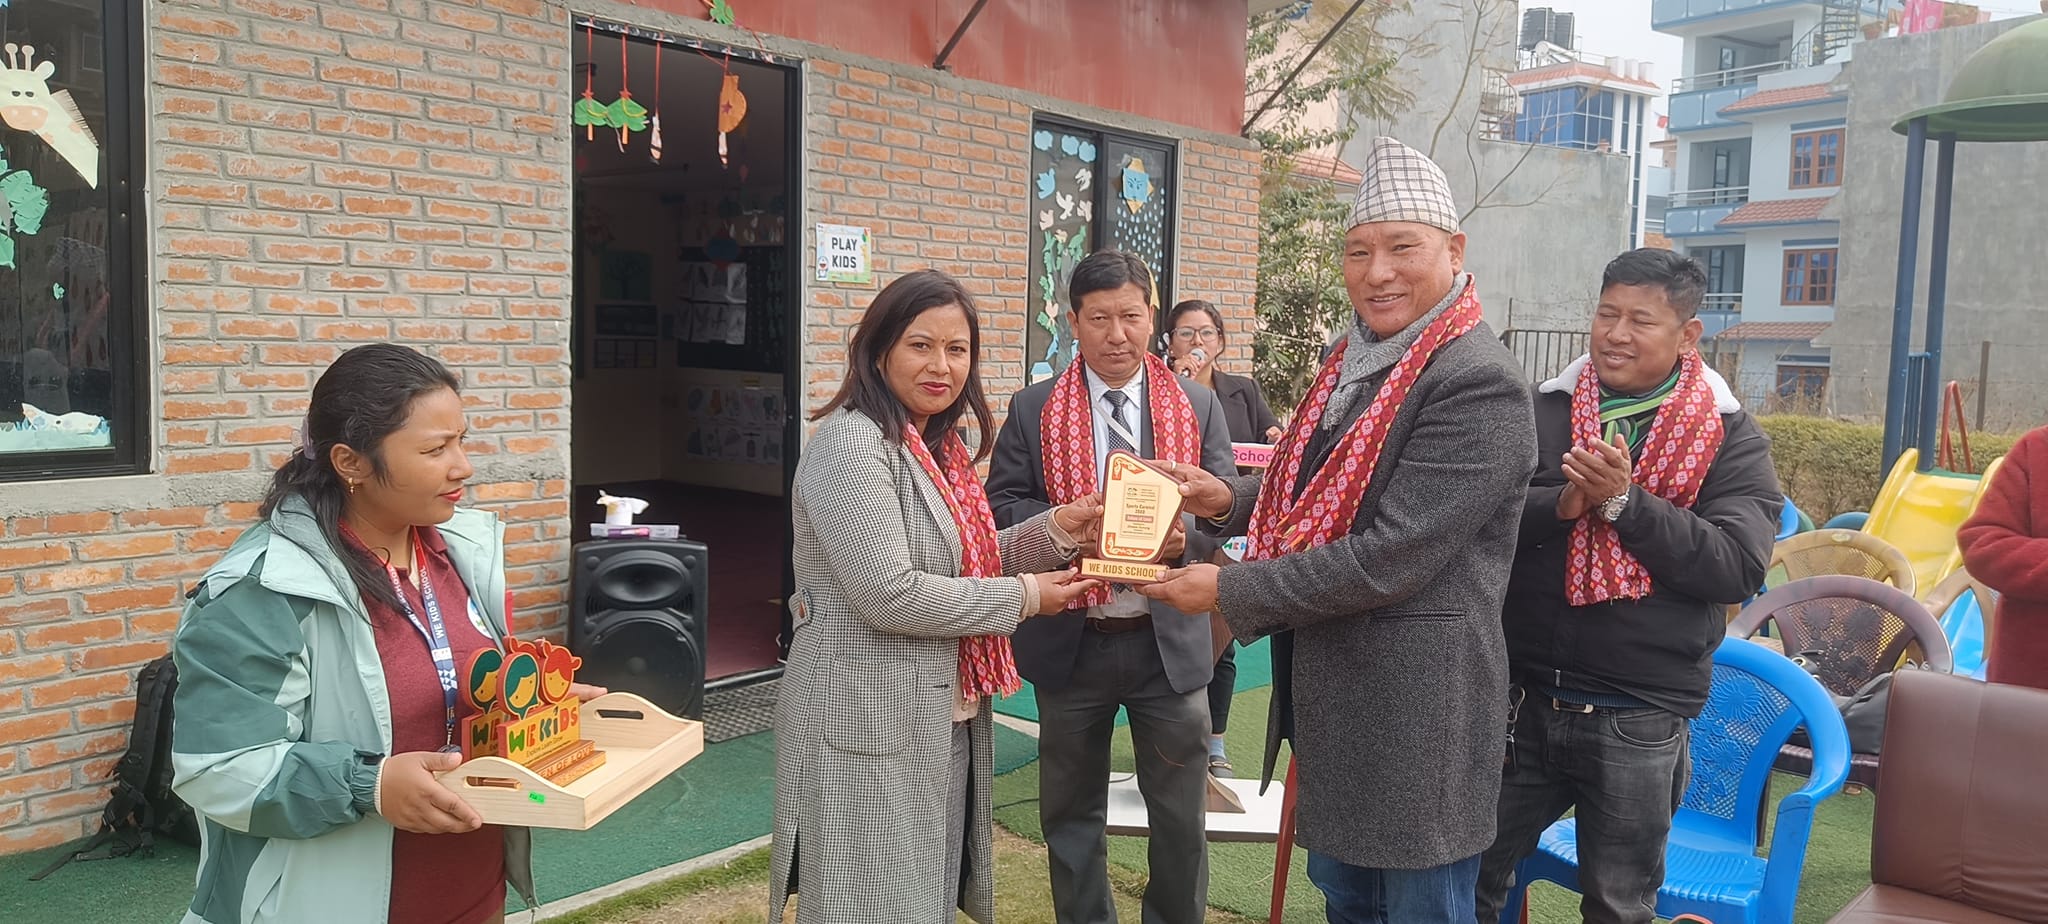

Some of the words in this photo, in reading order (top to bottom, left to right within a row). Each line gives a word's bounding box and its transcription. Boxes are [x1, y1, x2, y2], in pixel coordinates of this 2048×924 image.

[831, 237, 857, 251] PLAY
[832, 255, 857, 269] KIDS
[1232, 449, 1272, 463] Schoo
[1089, 563, 1101, 573] WE
[1103, 564, 1123, 575] KIDS
[420, 565, 433, 600] SCHOOL
[427, 601, 440, 622] KIDS
[433, 623, 445, 639] WE
[508, 723, 536, 753] WE
